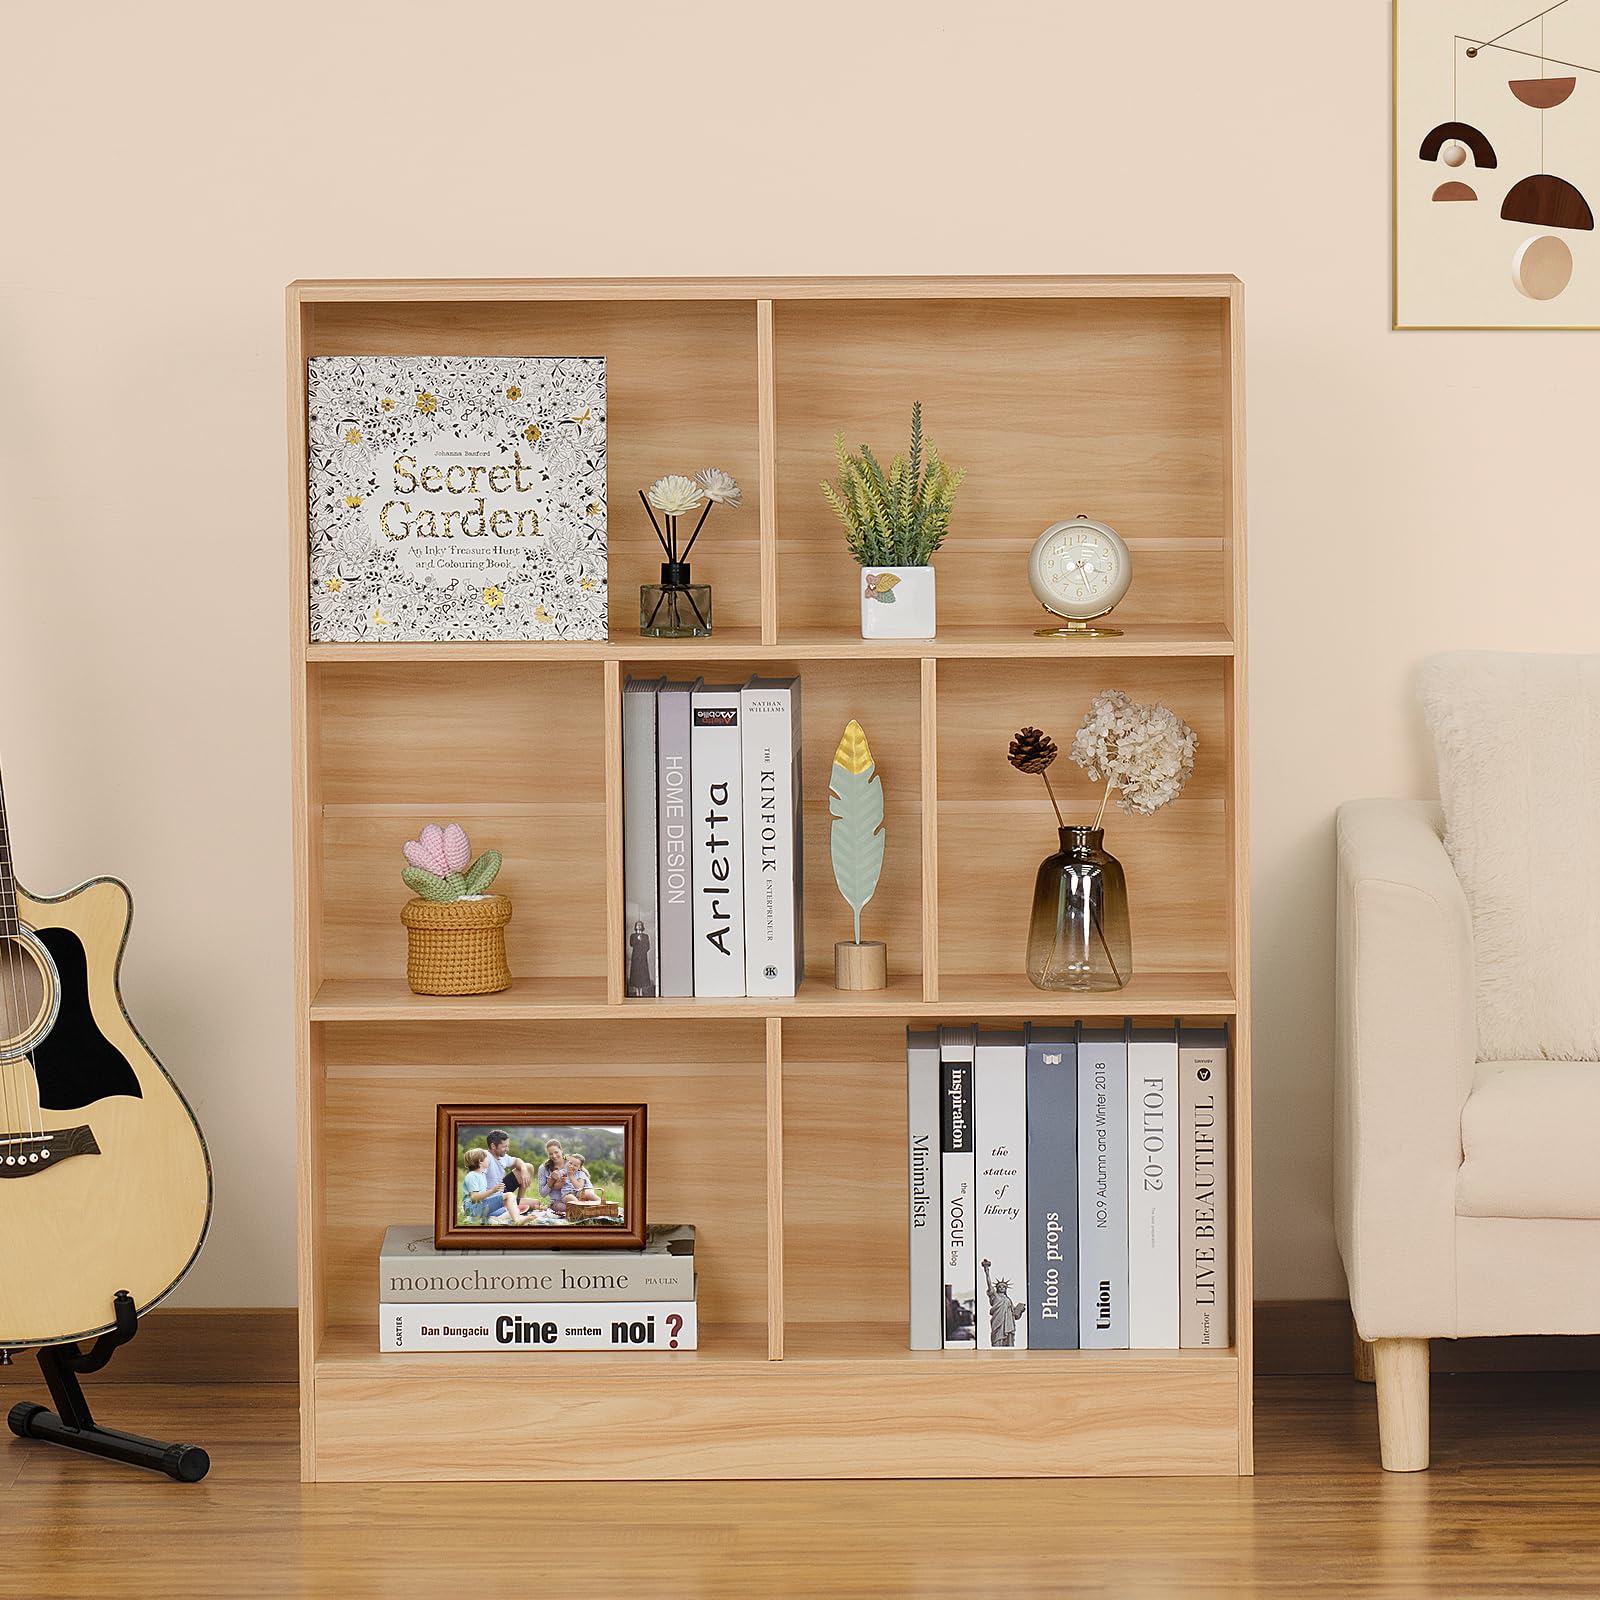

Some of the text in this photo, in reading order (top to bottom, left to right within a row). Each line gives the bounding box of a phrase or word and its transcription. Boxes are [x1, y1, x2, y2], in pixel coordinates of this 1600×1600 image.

[392, 450, 534, 495] Secret
[379, 498, 544, 542] Garden
[407, 545, 521, 559] An Inky Treasure Hunt
[415, 558, 516, 571] and Colouring Book
[1048, 559, 1055, 568] 9
[697, 711, 736, 719] Mobile
[666, 756, 684, 818] HOME
[761, 771, 777, 872] KINFOLK
[702, 782, 731, 956] Arletta
[948, 1068, 967, 1149] inspiration
[991, 1145, 1009, 1157] the
[1095, 1062, 1107, 1228] NO.9 Autumn and Winter 2018
[1143, 1077, 1164, 1191] FOLIO-02
[912, 1135, 930, 1228] Minimalista
[983, 1166, 1017, 1176] statue
[983, 1203, 1020, 1220] liberty
[994, 1184, 1009, 1200] of
[1195, 1095, 1215, 1306] LIVE BEAUTIFUL
[950, 1182, 968, 1267] the VOGUE blog
[390, 1268, 629, 1291] monochrome home
[659, 1277, 679, 1285] ULIN
[1042, 1212, 1063, 1320] Photo props
[1096, 1280, 1111, 1330] Union
[421, 1326, 489, 1338] Dan Dungaciu
[495, 1313, 684, 1349] Cine snntem noi ?
[1201, 1312, 1210, 1345] Interior
